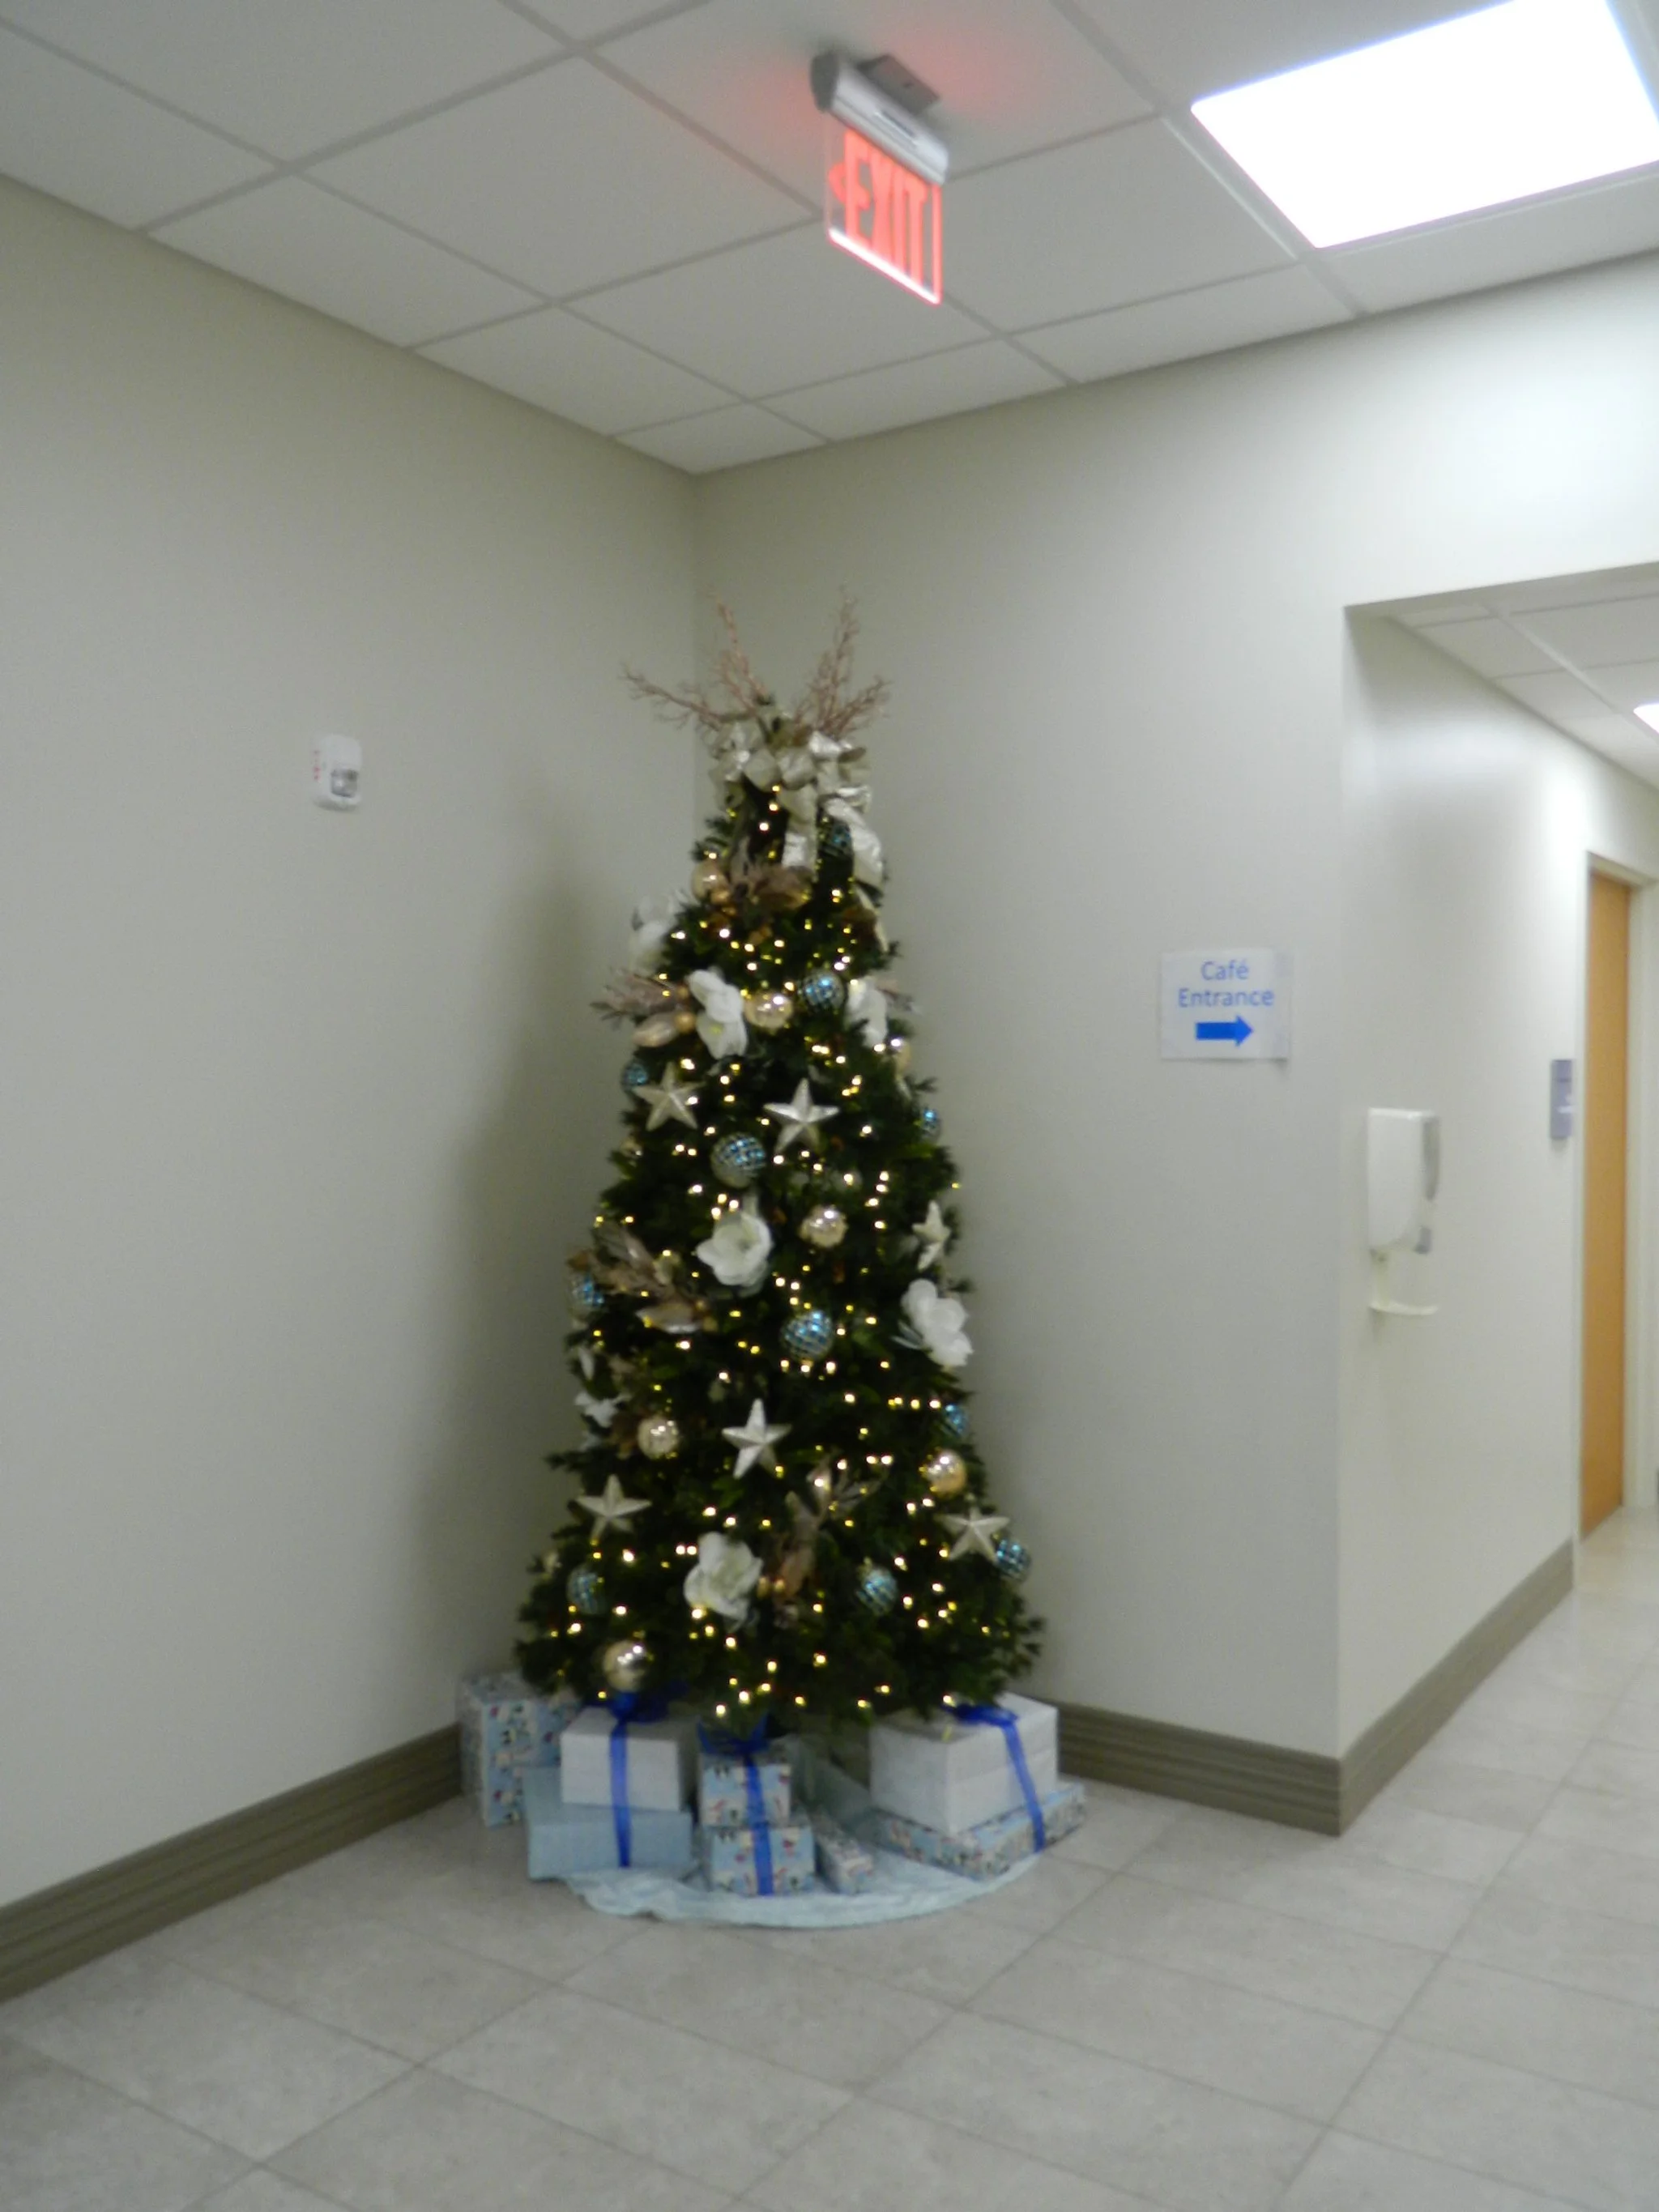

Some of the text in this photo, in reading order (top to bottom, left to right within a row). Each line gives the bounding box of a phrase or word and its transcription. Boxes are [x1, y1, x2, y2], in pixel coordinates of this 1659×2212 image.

[844, 129, 928, 287] EXIT
[1201, 959, 1249, 981] Café
[1178, 987, 1275, 1008] Entrance
